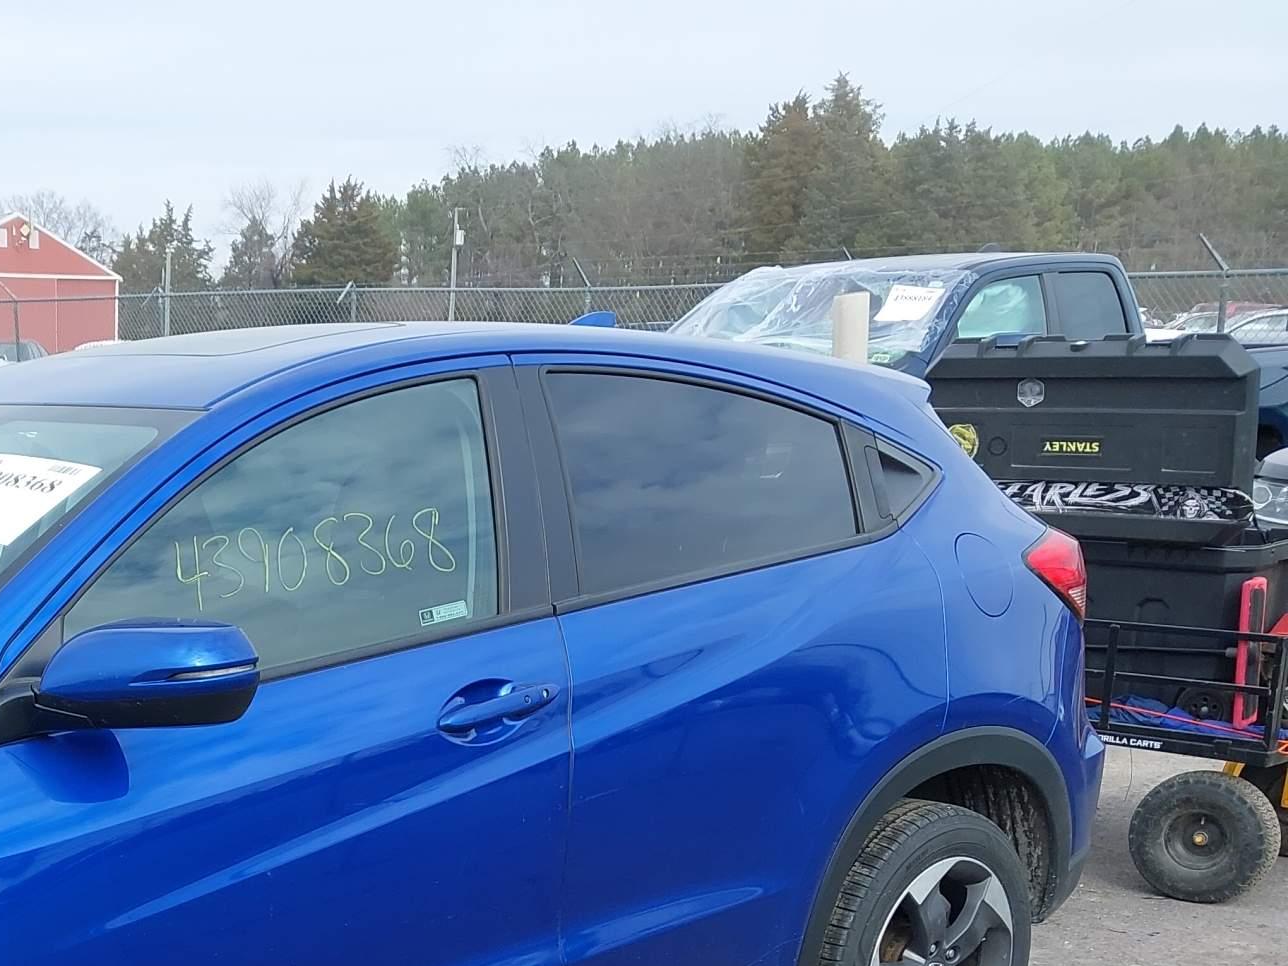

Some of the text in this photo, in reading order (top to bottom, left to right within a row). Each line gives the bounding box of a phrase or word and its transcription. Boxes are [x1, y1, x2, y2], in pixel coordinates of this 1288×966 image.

[1043, 441, 1100, 453] STANLEY
[175, 508, 456, 611] 43908368
[1130, 739, 1162, 749] CARTS
